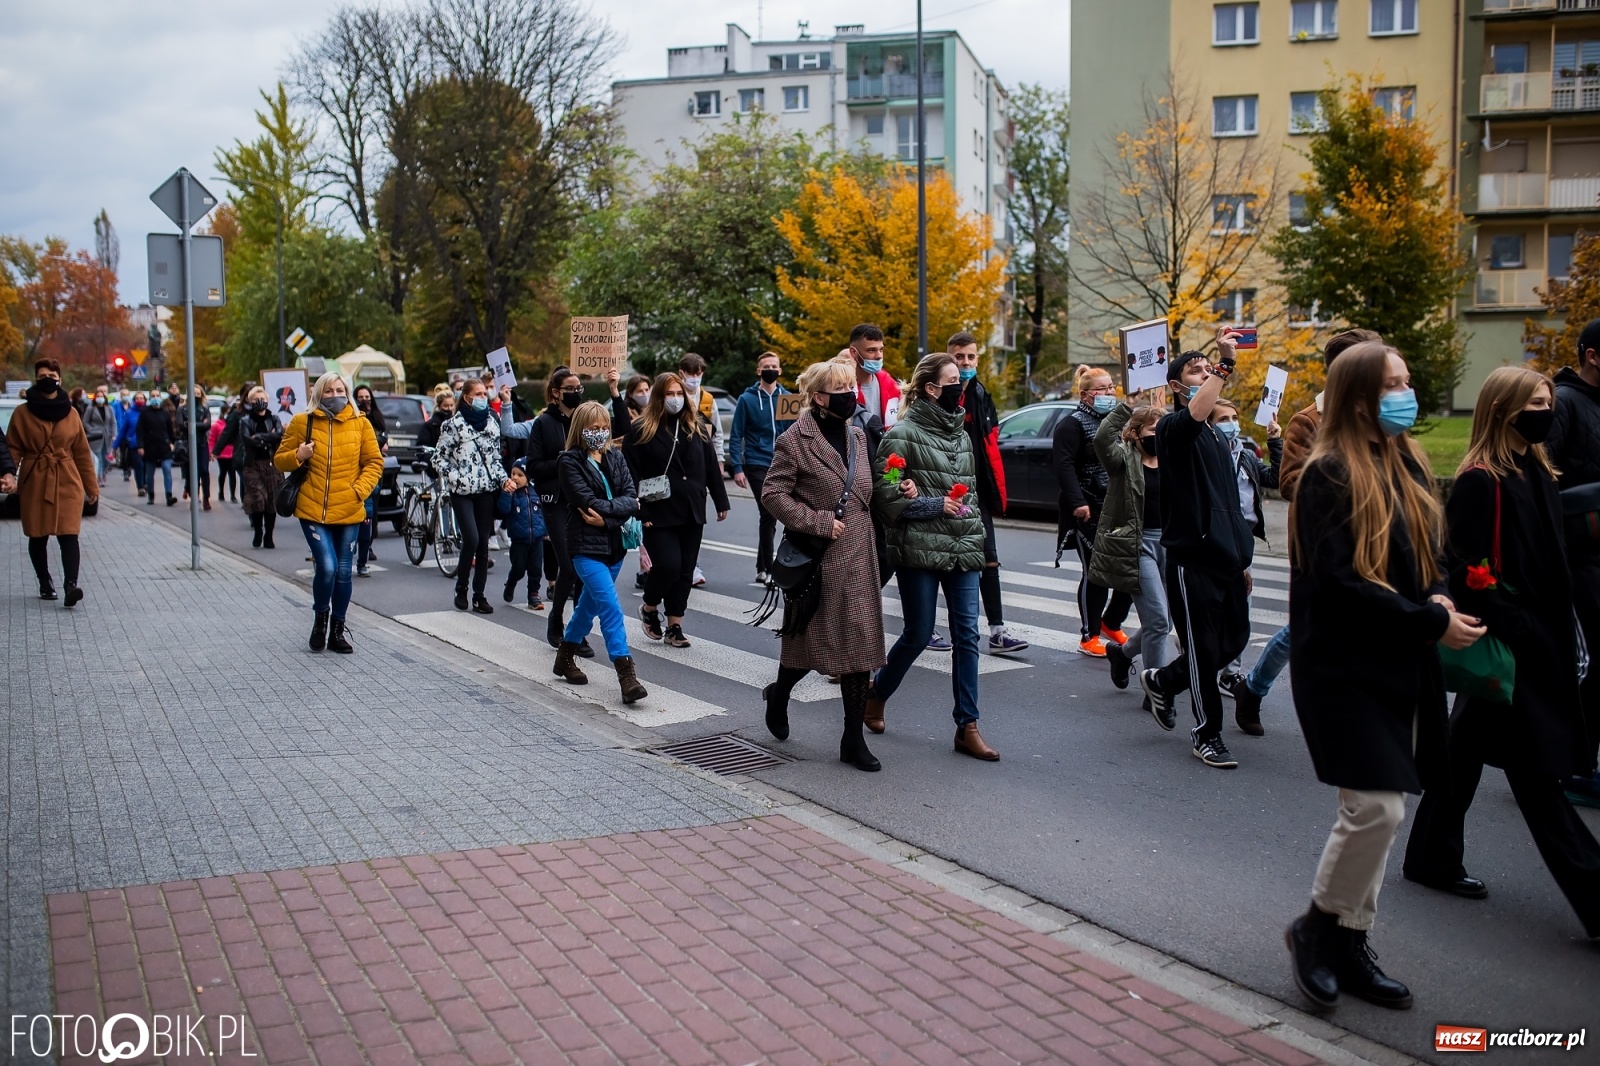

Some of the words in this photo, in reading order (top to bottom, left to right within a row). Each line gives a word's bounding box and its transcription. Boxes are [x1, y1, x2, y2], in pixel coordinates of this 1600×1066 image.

[571, 321, 595, 333] GDYBY
[597, 321, 608, 333] TO
[573, 334, 616, 344] ZACHODZILI
[580, 346, 590, 354] TO
